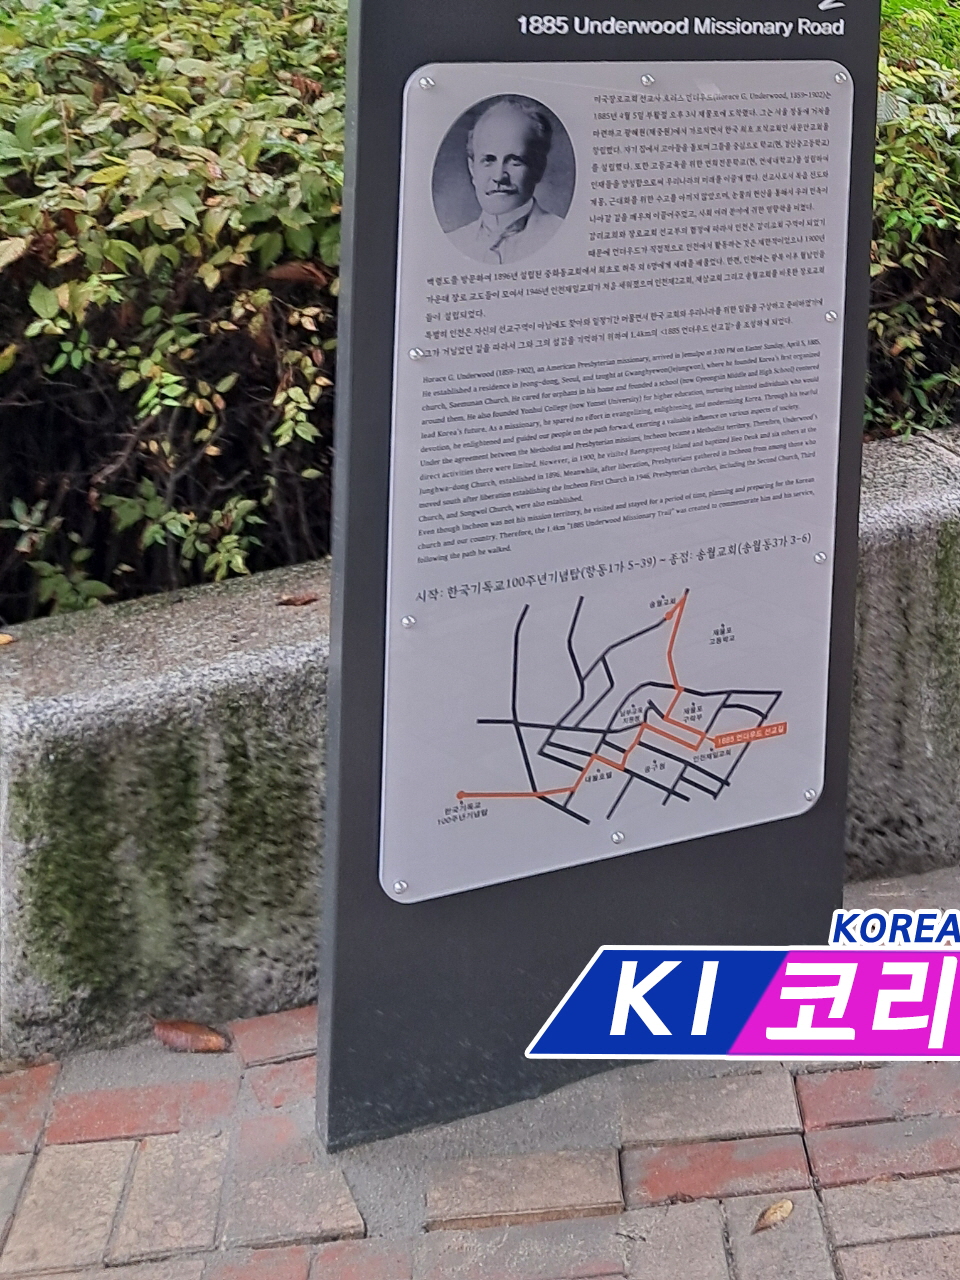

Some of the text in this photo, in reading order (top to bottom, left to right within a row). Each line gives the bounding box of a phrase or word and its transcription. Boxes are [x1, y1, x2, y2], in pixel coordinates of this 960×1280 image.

[518, 16, 845, 39] 1885 Underwood Missionary Road
